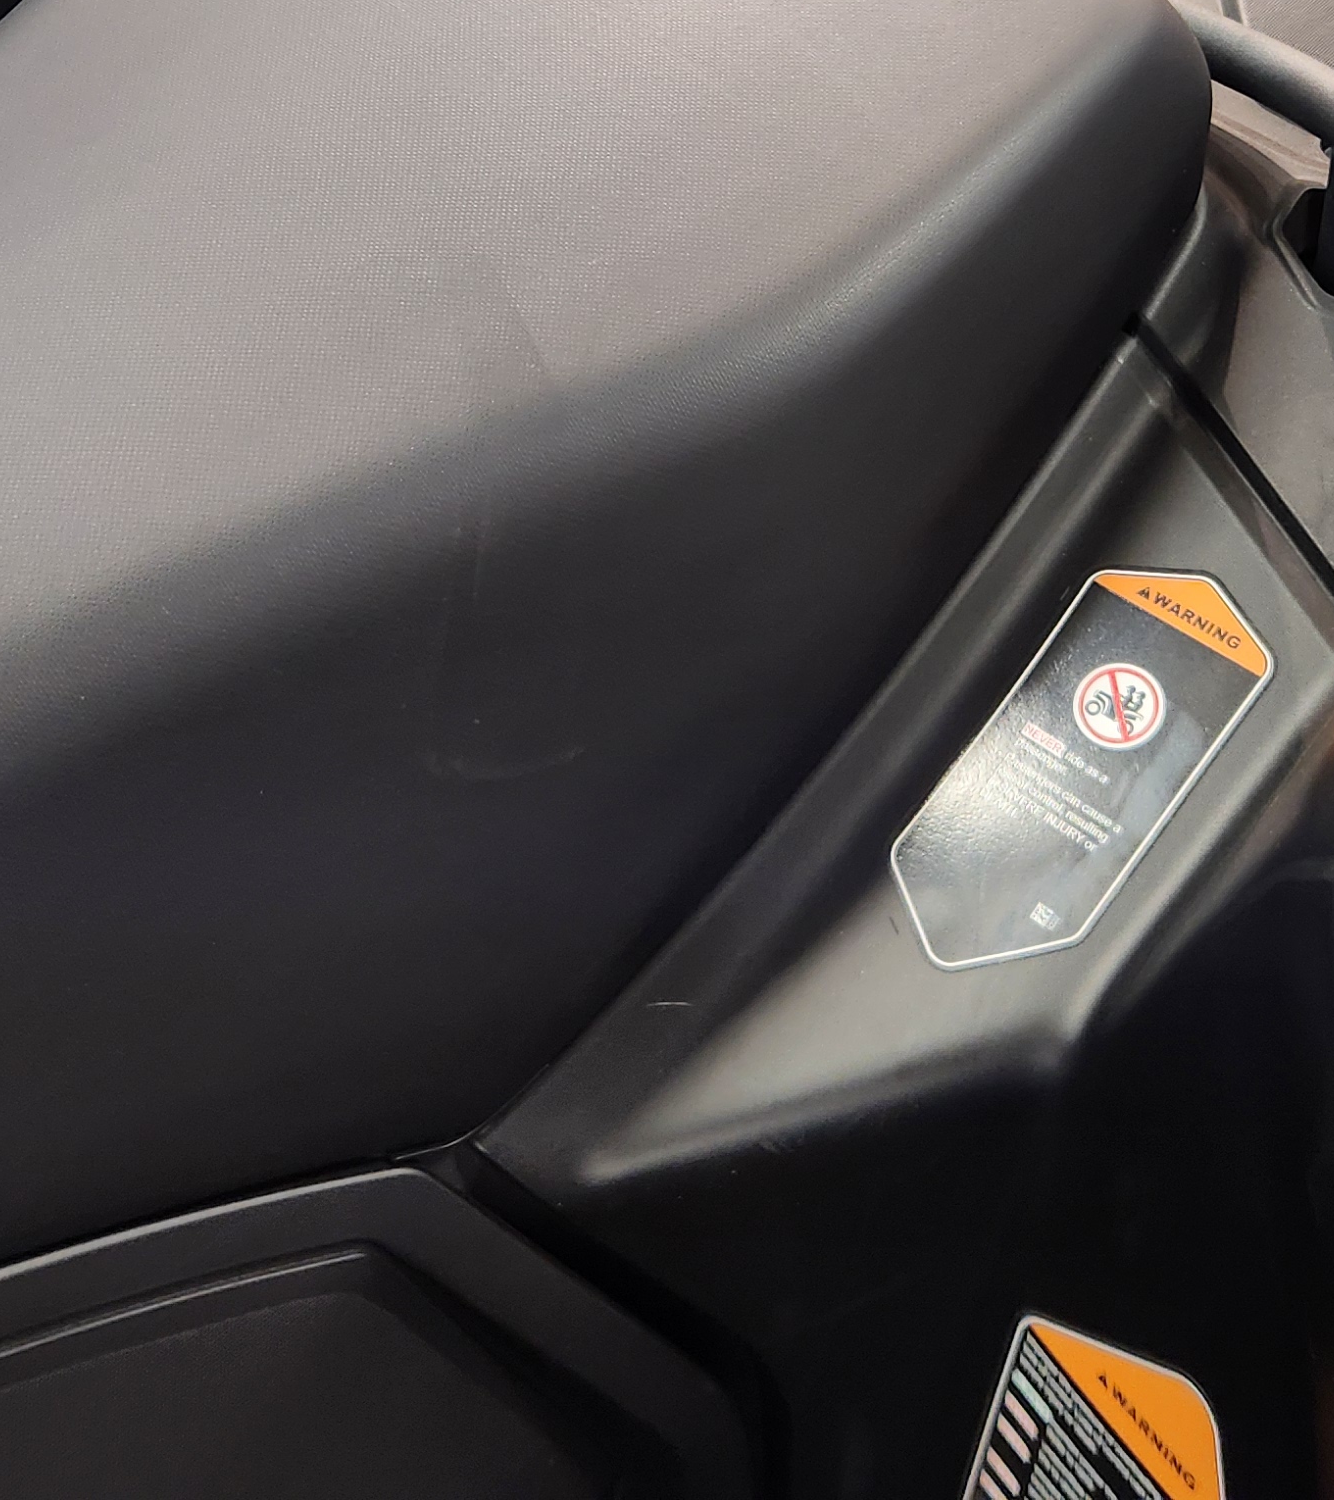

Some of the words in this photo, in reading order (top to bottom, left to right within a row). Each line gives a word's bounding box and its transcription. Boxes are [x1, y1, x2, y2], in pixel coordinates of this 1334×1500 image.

[1153, 590, 1242, 651] WARNING
[1023, 723, 1064, 754] NEVER
[1064, 751, 1085, 770] ride
[1085, 767, 1098, 779] as
[1099, 774, 1109, 785] a
[1043, 811, 1085, 843] INJURY
[1085, 839, 1098, 851] or
[1061, 791, 1080, 809] can
[1081, 804, 1113, 828] cause
[1065, 810, 1109, 843] resulting
[1112, 1382, 1197, 1491] WARNING
